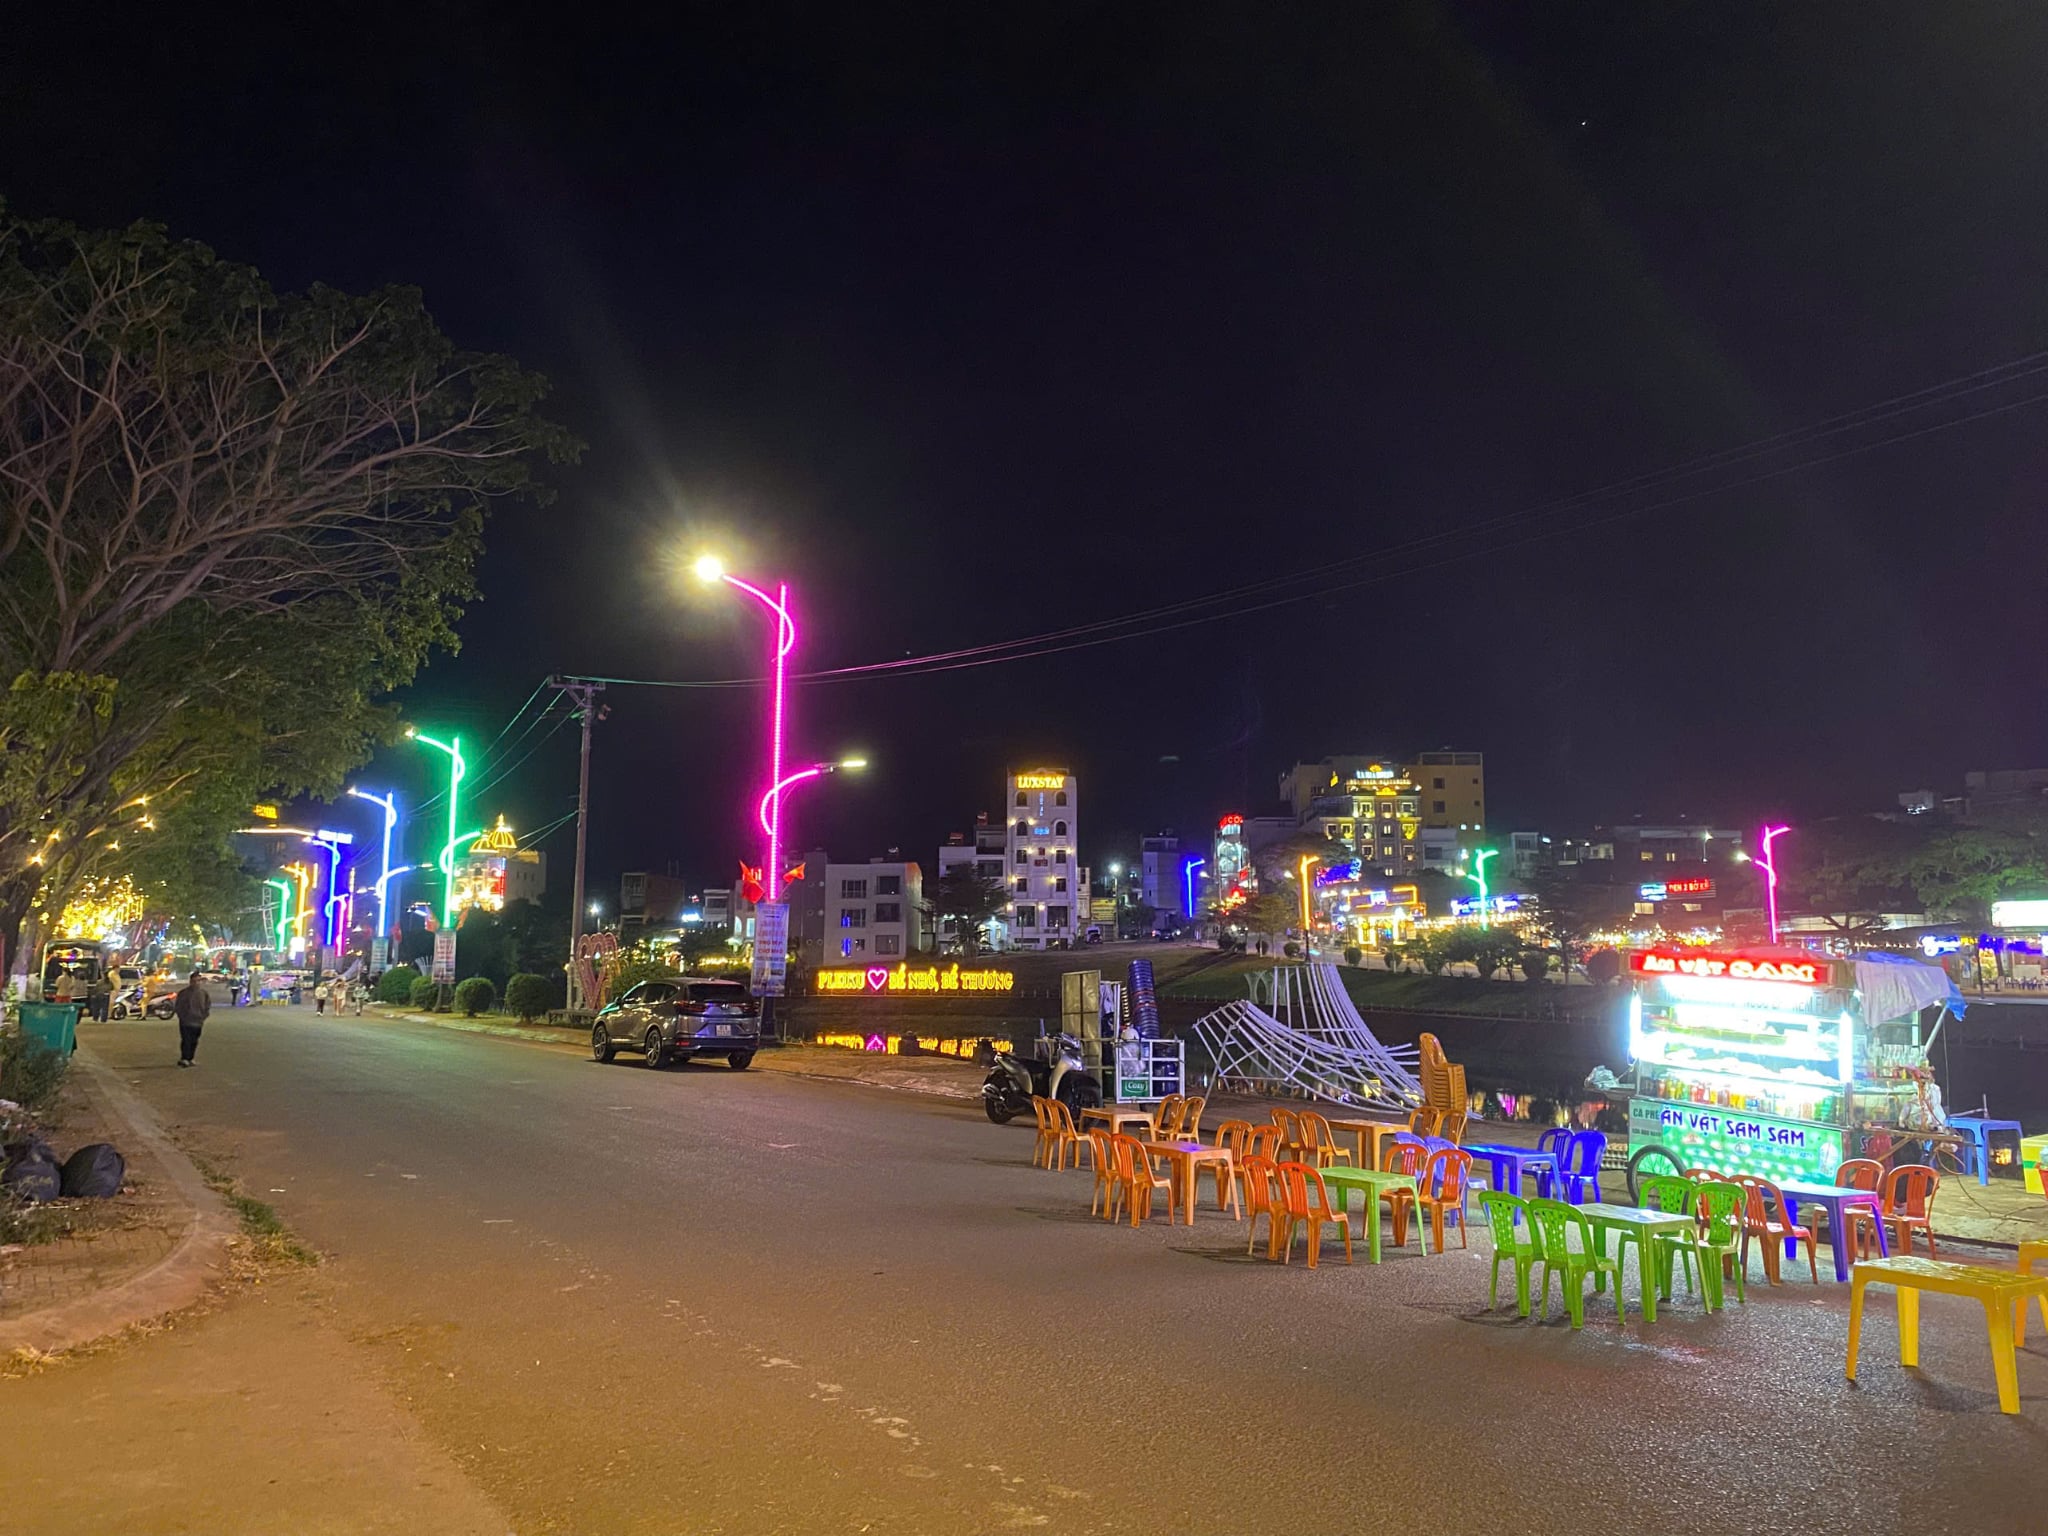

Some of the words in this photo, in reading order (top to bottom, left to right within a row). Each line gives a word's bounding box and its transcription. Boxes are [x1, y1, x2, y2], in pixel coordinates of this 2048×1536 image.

[1018, 775, 1064, 789] LUXSTAY
[818, 971, 865, 990] PLEIKU
[960, 969, 1014, 990] THƯƠNG
[1730, 961, 1815, 982] SAM
[1661, 1106, 1683, 1126] ĂN
[1689, 1112, 1719, 1136] VẶT
[1726, 1120, 1760, 1140] SAM
[1768, 1127, 1805, 1147] SAM
